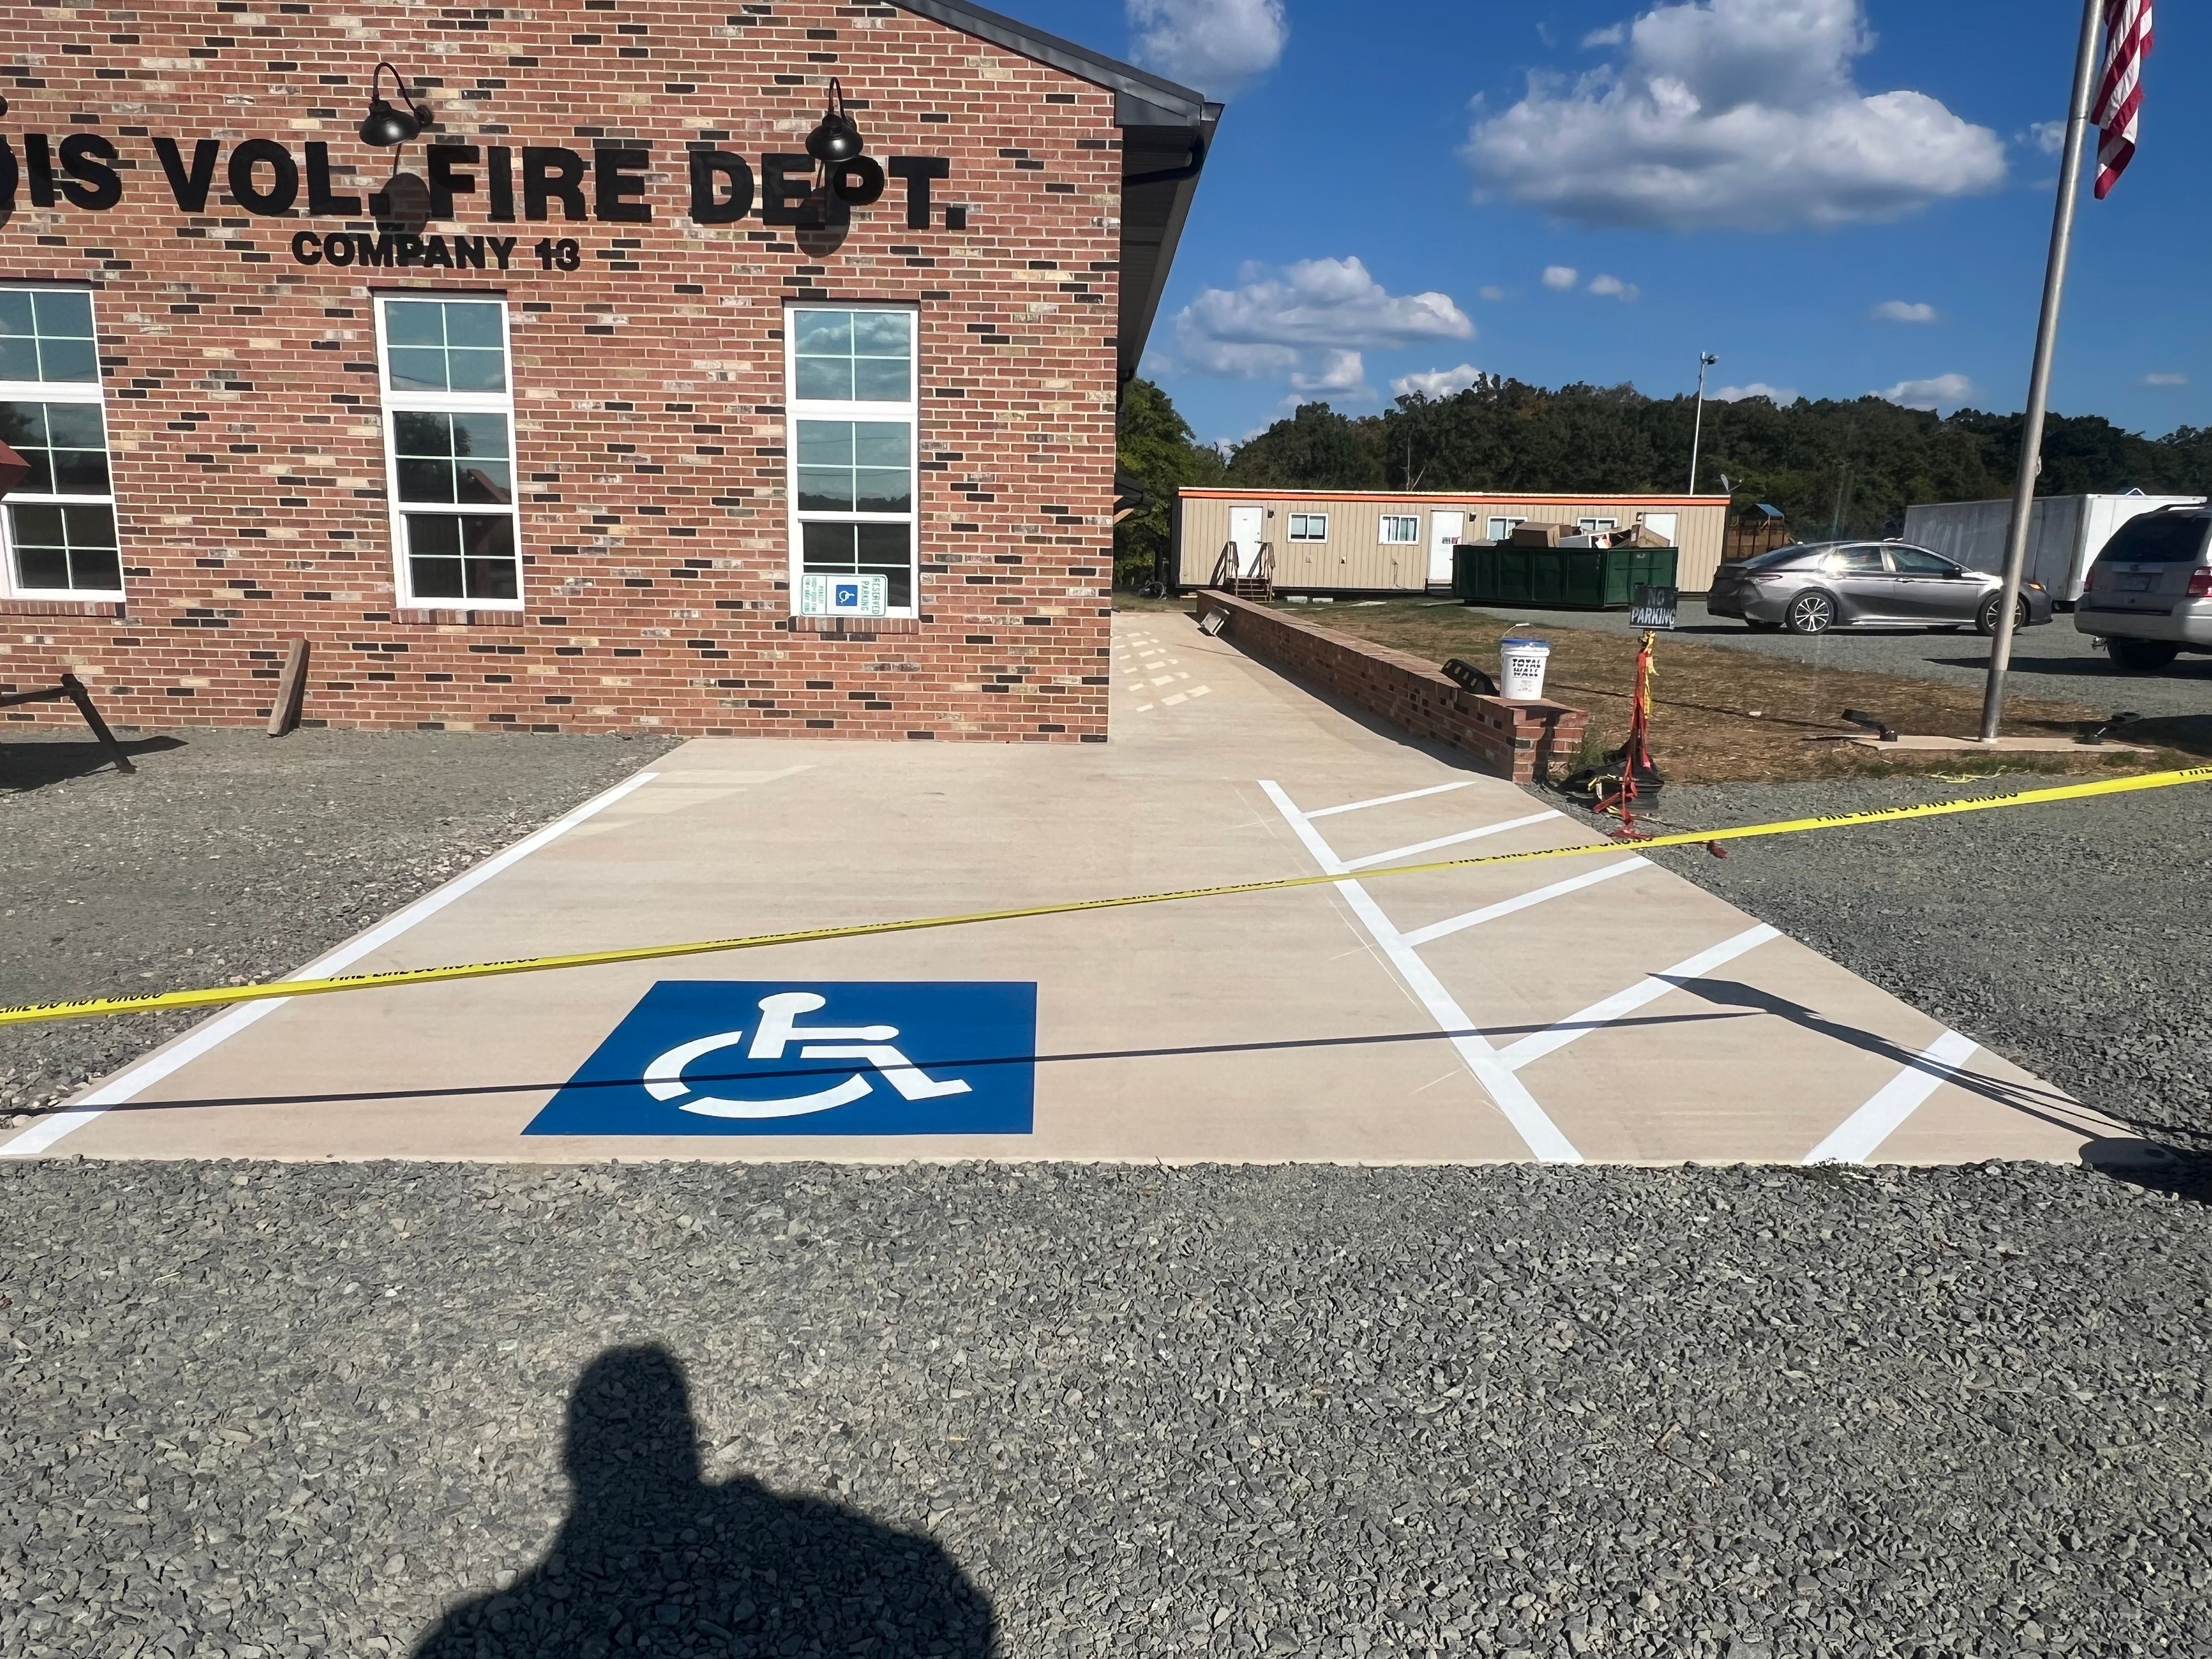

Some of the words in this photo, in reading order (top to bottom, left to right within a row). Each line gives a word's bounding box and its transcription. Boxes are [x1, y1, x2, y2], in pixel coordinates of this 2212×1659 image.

[0, 133, 122, 210] IS
[151, 137, 390, 216] VOL.
[427, 144, 652, 223] FIRE
[689, 150, 966, 230] DEPT.
[291, 231, 517, 270] COMPANY
[535, 238, 580, 272] 13
[872, 578, 880, 614] RESERVED
[1648, 589, 1664, 606] NO
[1631, 607, 1675, 625] PARKING
[1513, 658, 1540, 668] TOTAL
[1513, 668, 1538, 677] WALL
